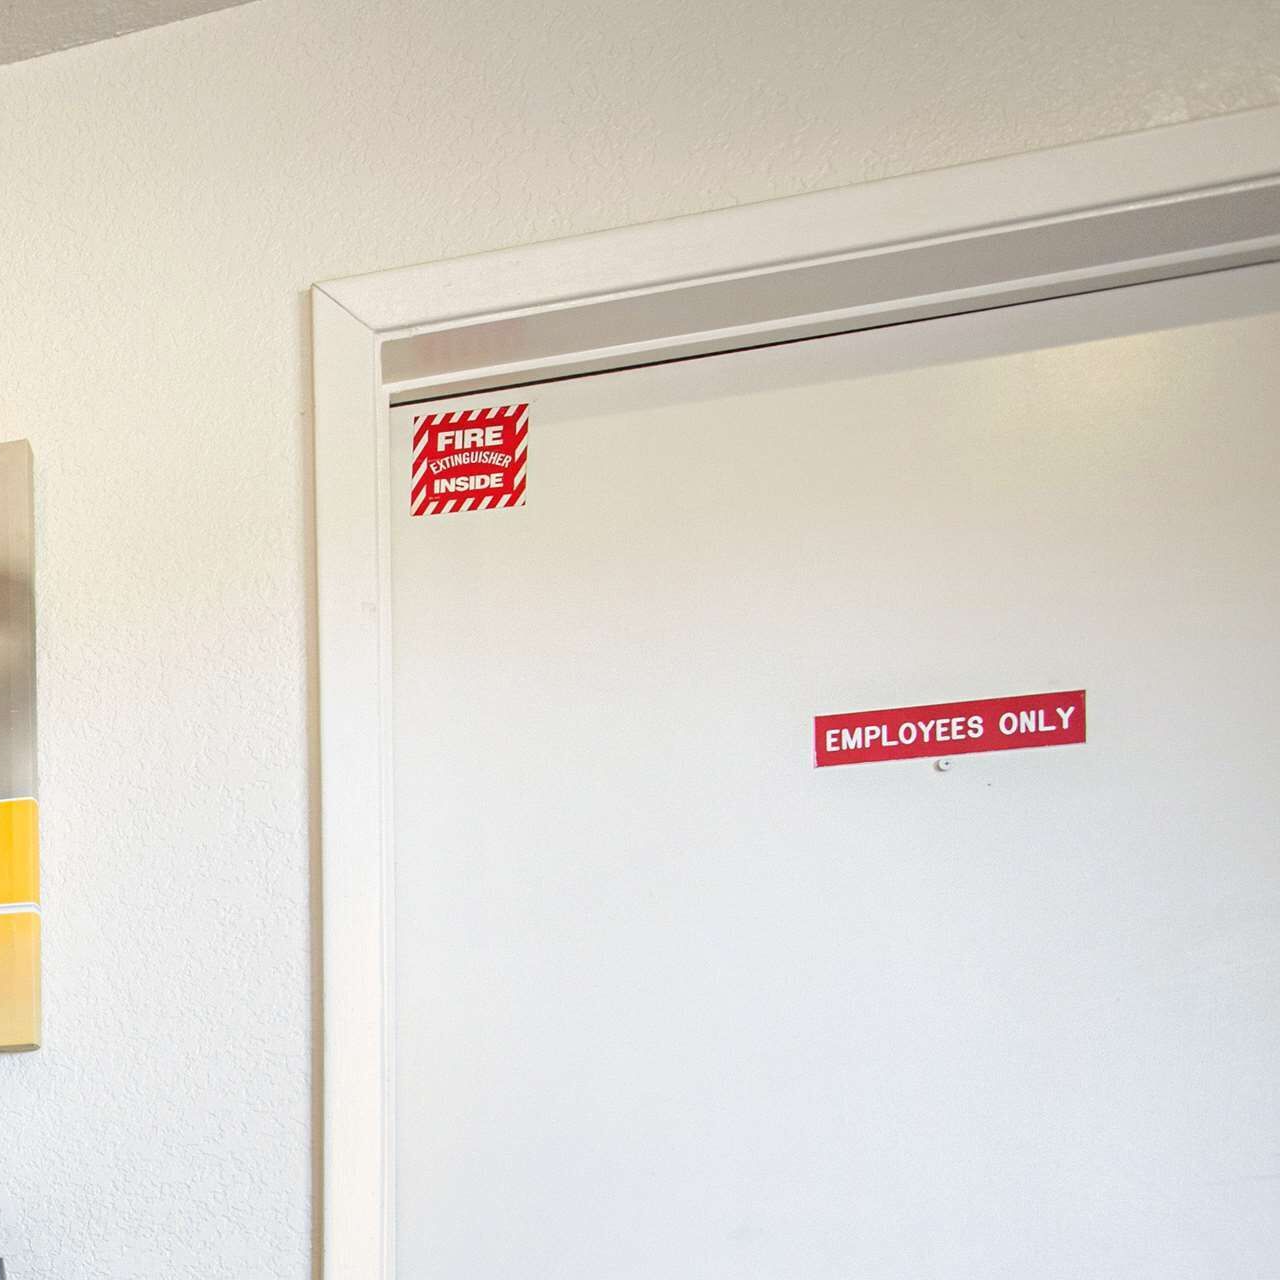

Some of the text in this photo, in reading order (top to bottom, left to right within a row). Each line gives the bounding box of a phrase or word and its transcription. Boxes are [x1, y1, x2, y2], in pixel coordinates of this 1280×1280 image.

[437, 425, 504, 452] FIRE
[429, 450, 512, 475] EXTINGUISHER
[433, 472, 504, 494] INSIDE
[825, 706, 1075, 752] EMPLOYEES ONLY
